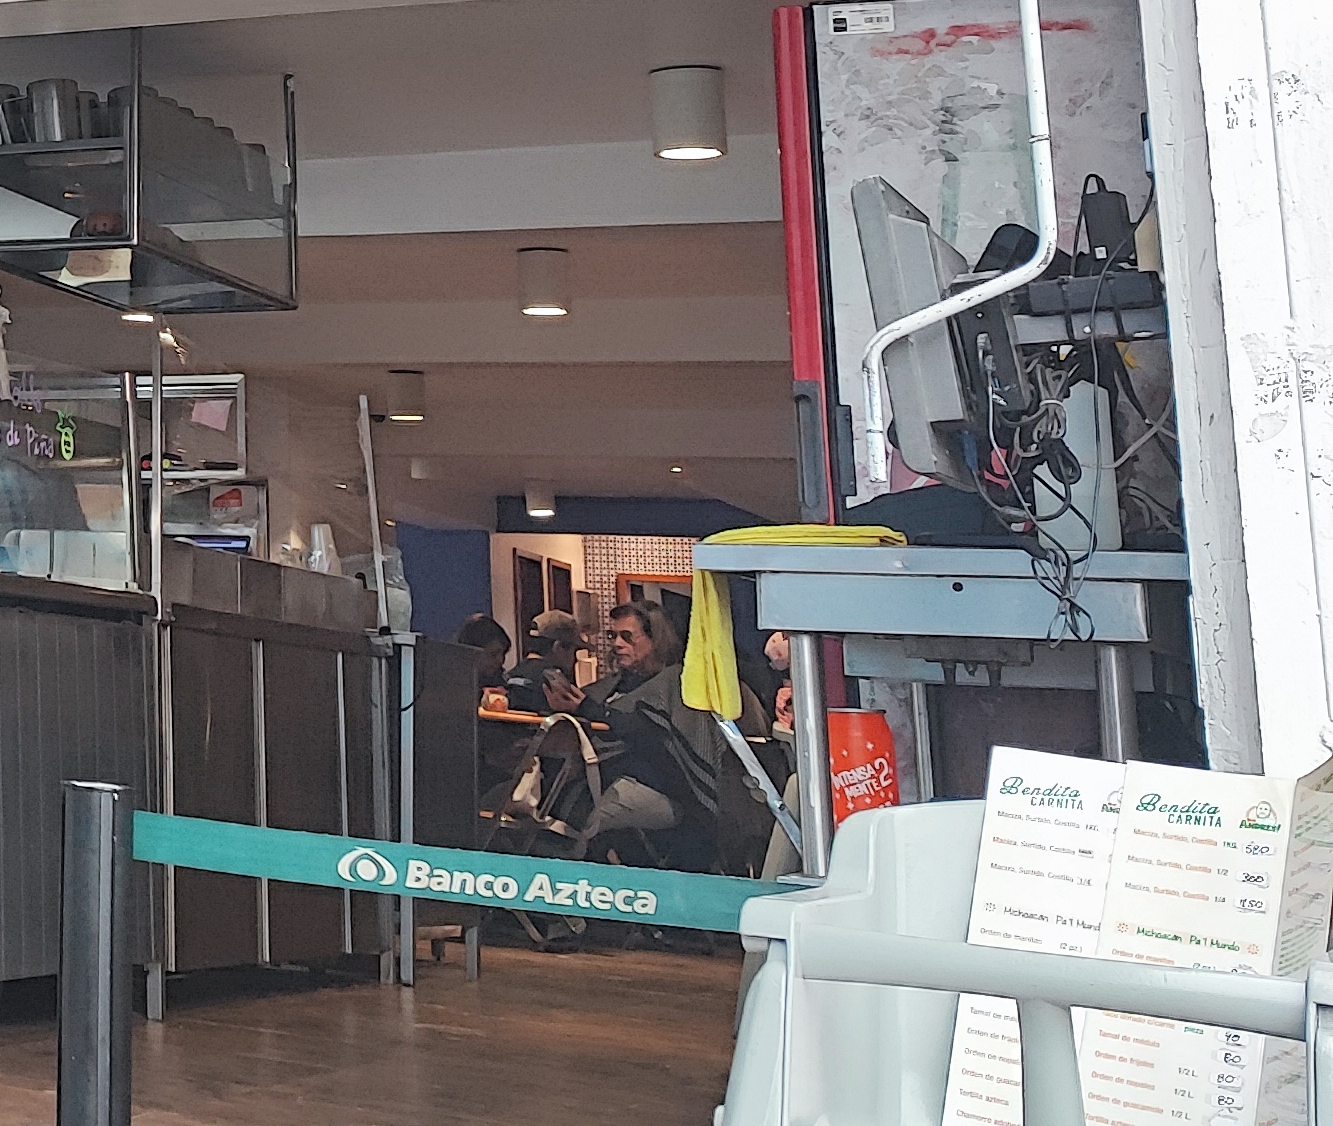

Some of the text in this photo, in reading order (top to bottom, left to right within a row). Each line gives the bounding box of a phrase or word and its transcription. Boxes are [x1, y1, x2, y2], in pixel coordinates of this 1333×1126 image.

[831, 757, 893, 791] NTENSA 2
[999, 776, 1081, 798] Bendita
[1030, 796, 1084, 811] CARNITA
[1136, 793, 1221, 815] Bendita
[1167, 813, 1222, 828] CARNITA
[405, 858, 659, 917] Banco Azteca
